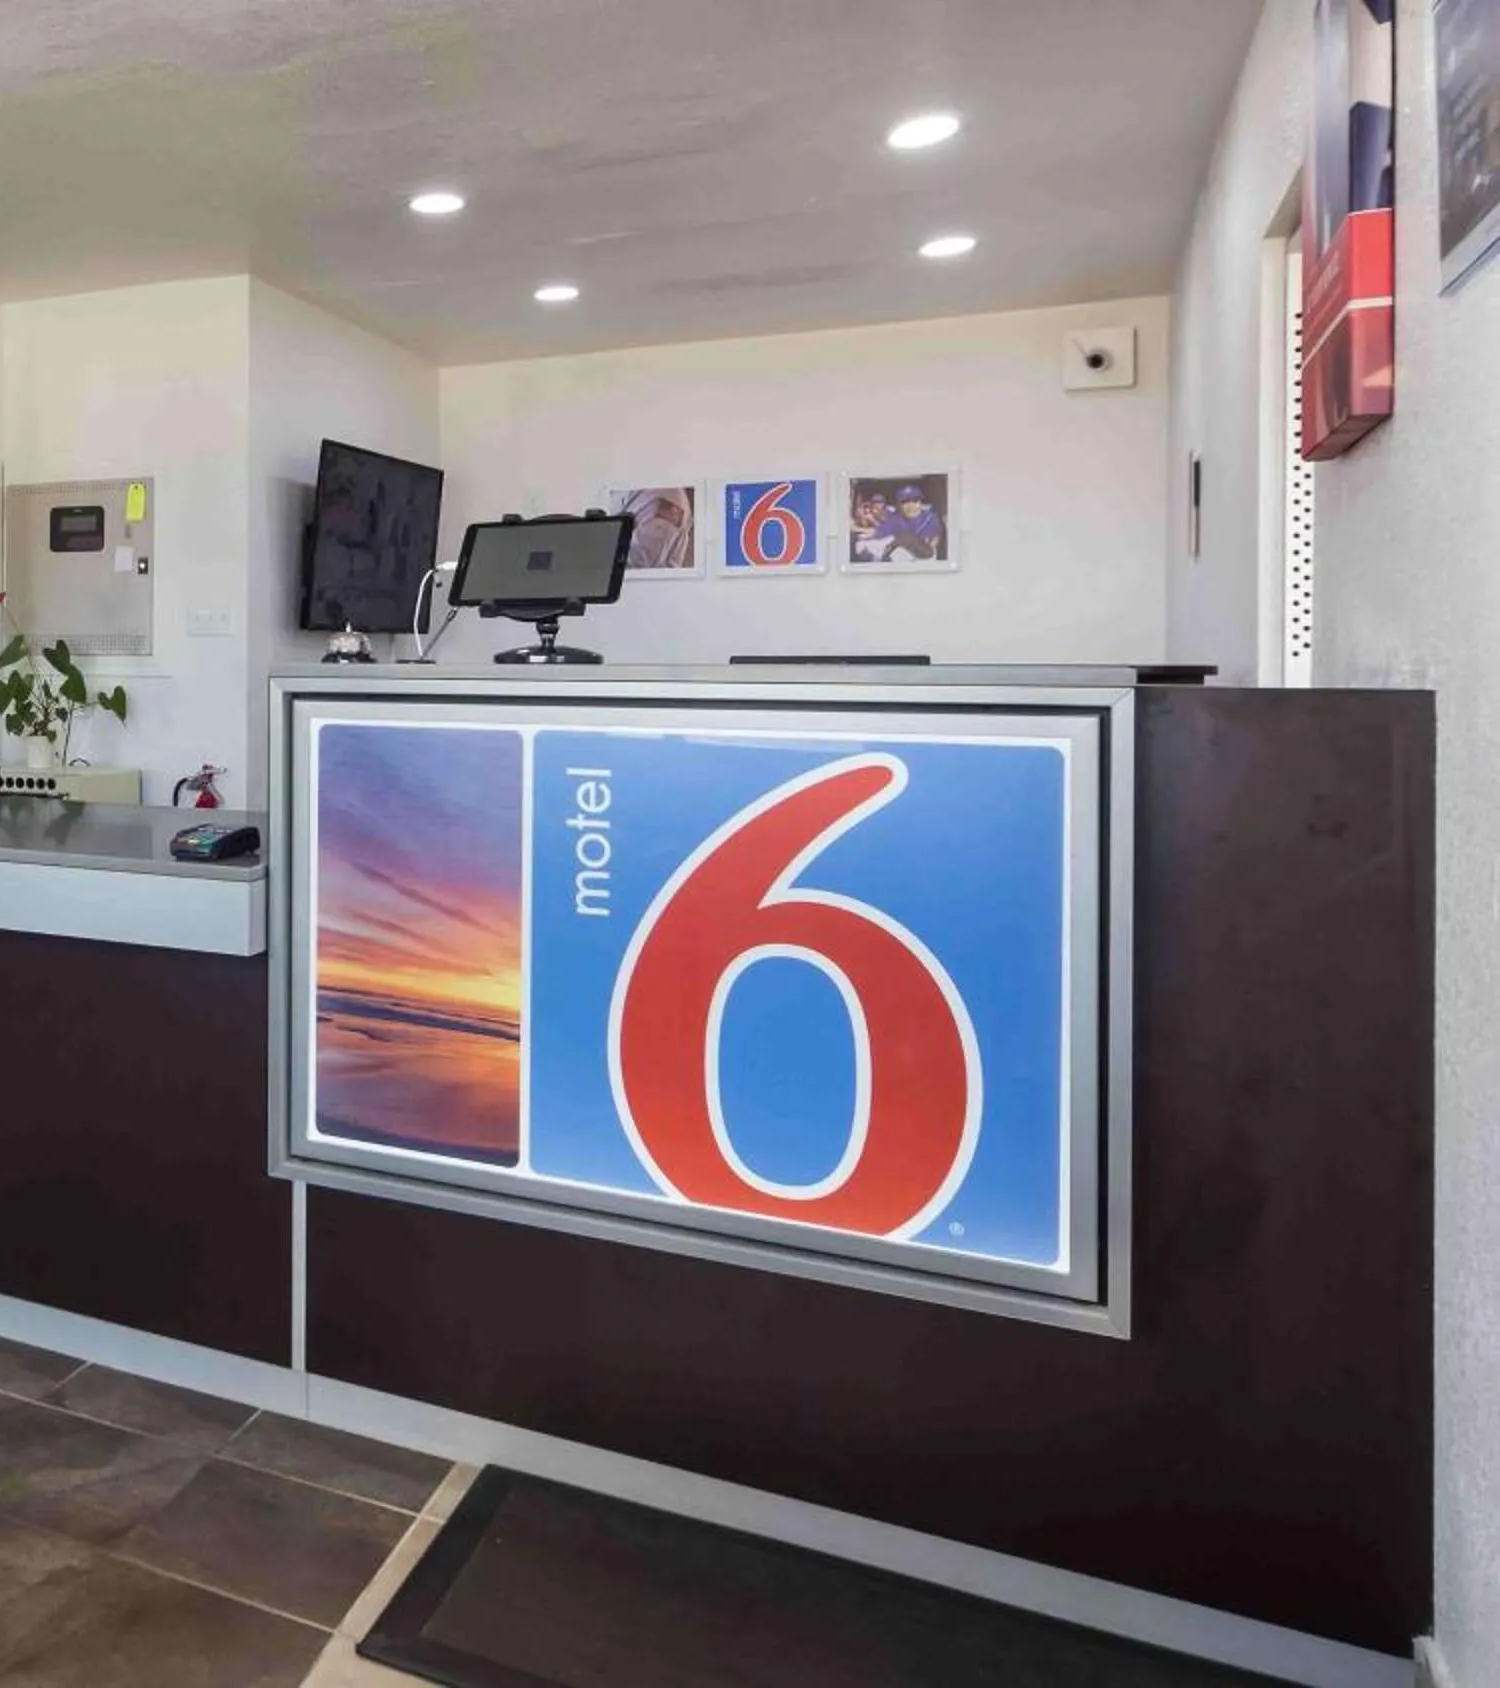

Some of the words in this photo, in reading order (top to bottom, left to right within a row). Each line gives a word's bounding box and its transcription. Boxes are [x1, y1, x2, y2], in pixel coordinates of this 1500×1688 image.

[740, 483, 805, 567] 6
[565, 767, 612, 917] motel
[607, 752, 984, 1243] 6
